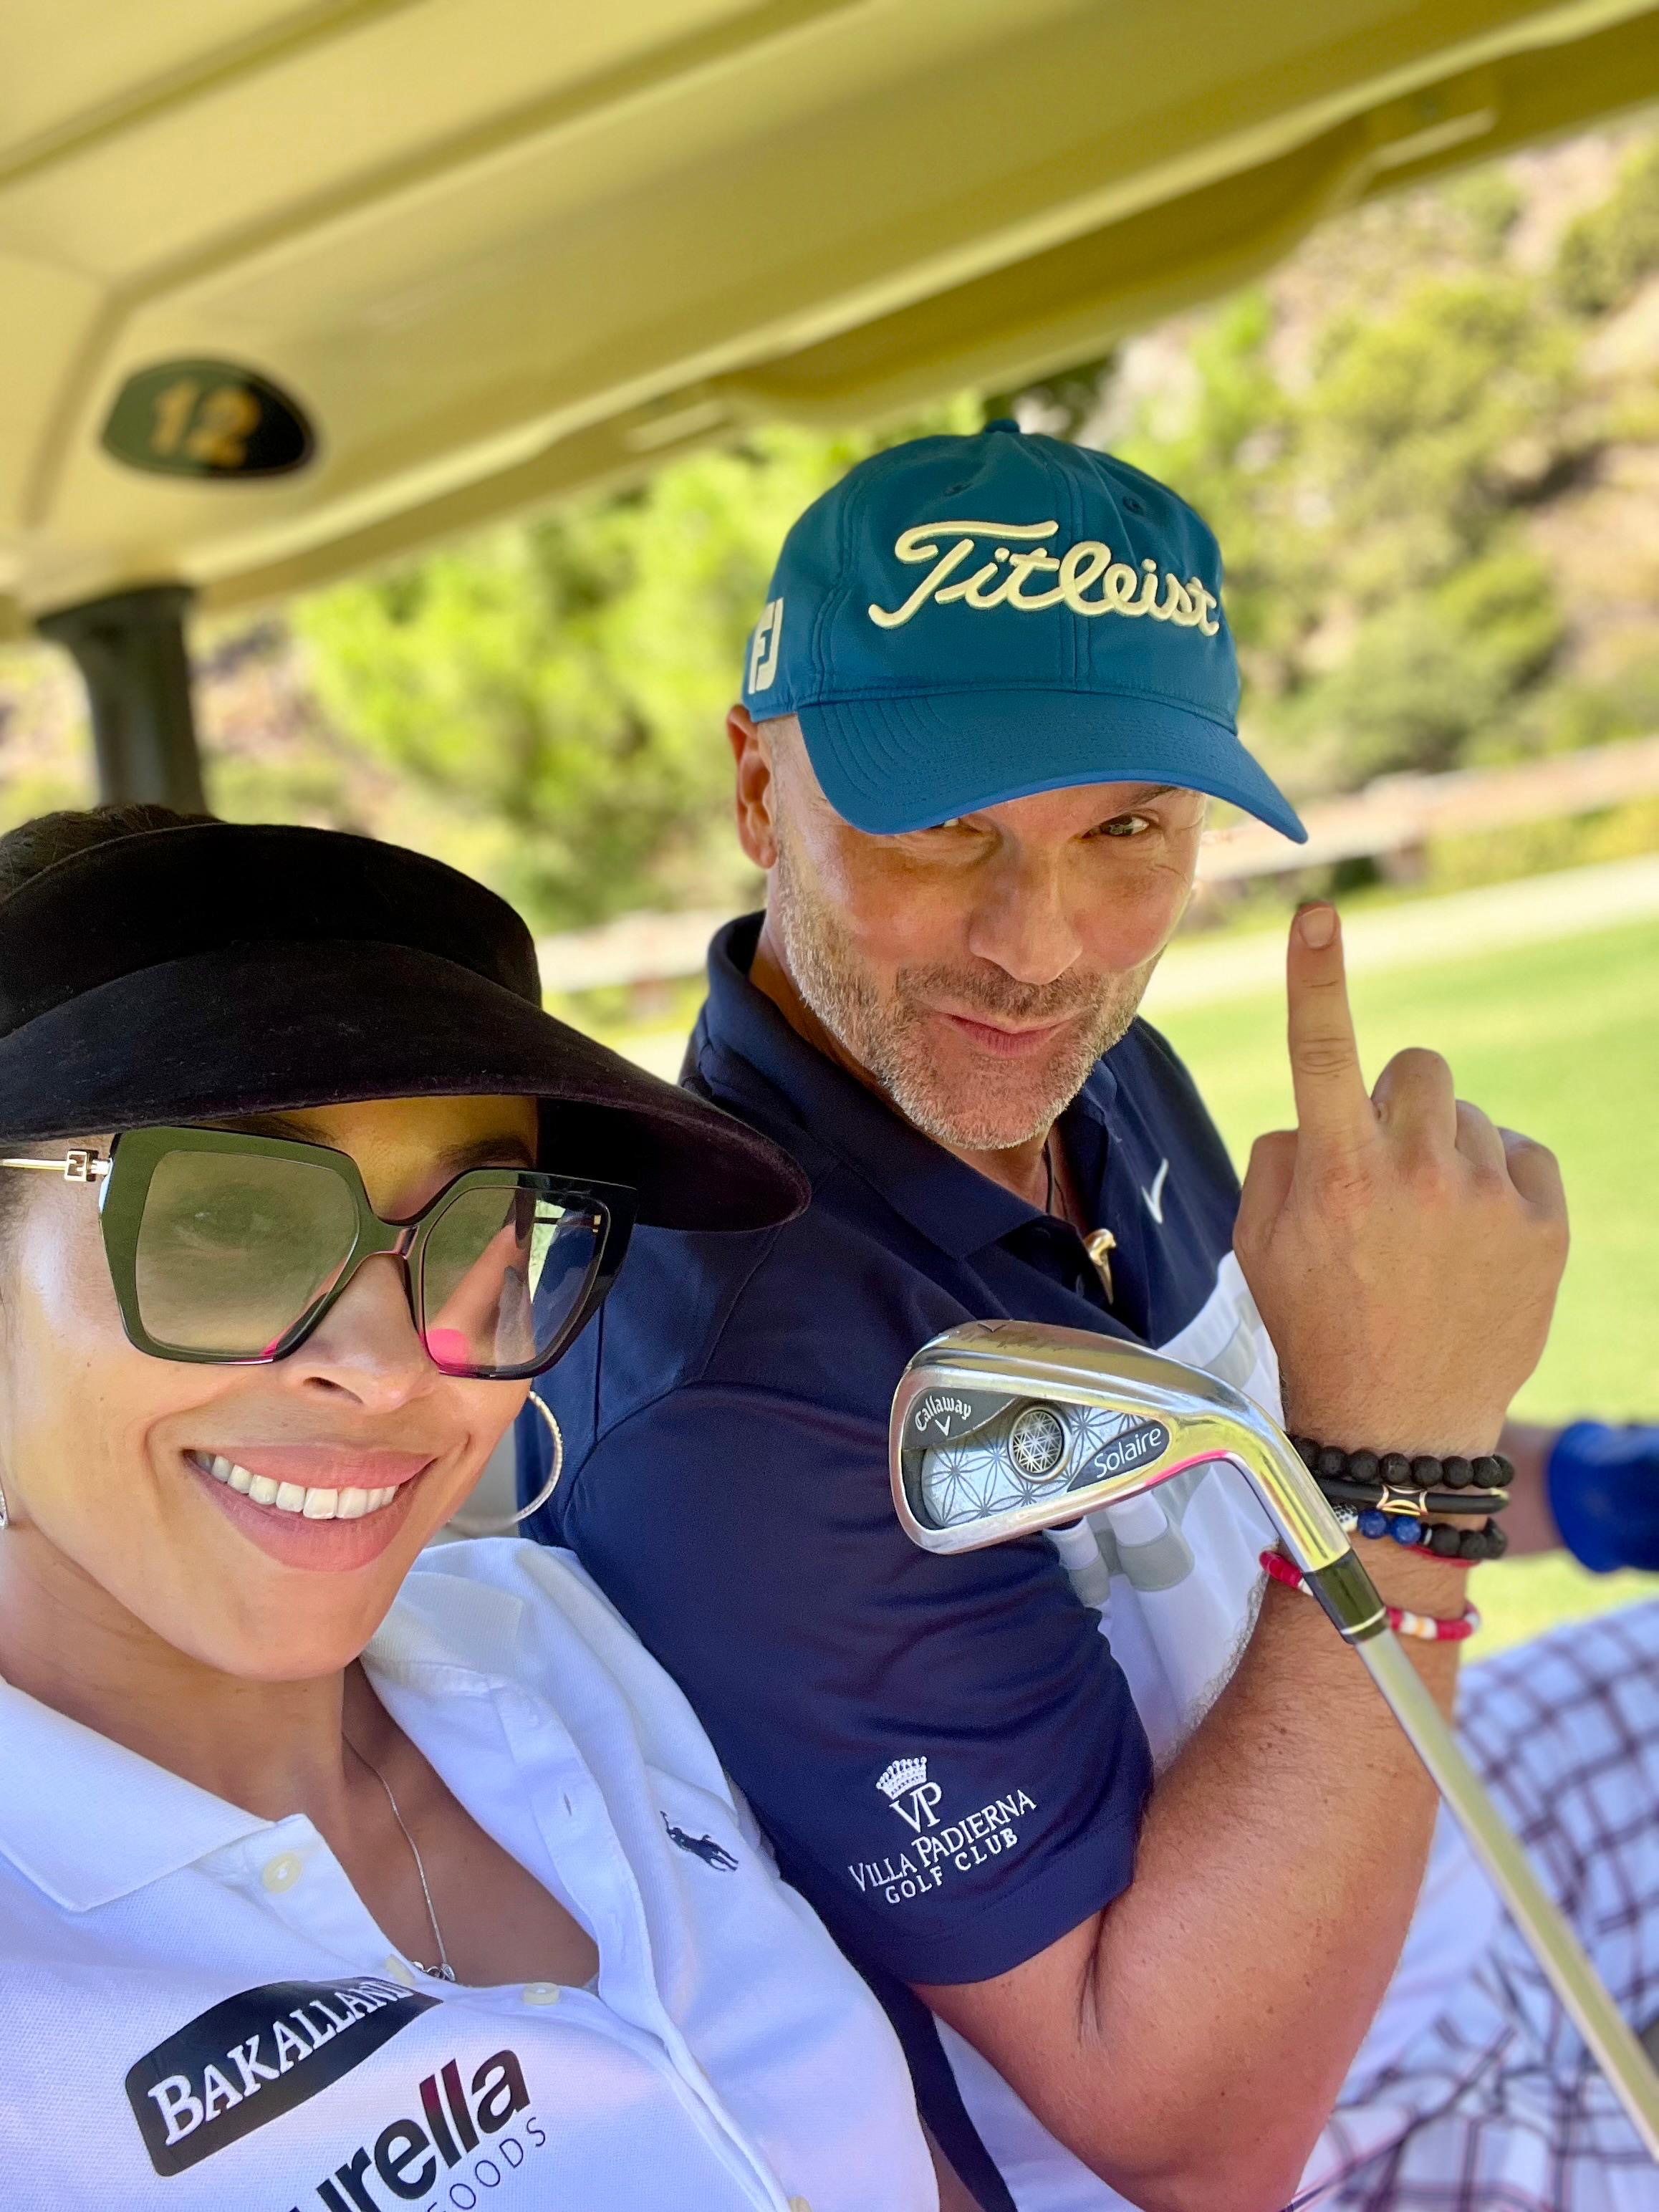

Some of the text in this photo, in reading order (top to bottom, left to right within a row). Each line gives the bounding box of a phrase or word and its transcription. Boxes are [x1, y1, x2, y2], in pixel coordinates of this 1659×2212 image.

[149, 377, 260, 468] 12
[868, 519, 1220, 637] Titleist
[915, 1395, 972, 1432] Callaway
[1093, 1427, 1162, 1478] Solaire
[847, 1789, 1037, 1893] VILLA PADIERNA
[888, 1781, 943, 1834] VP
[885, 1827, 1019, 1904] GOLF CLUB
[427, 2116, 547, 2212] OODS
